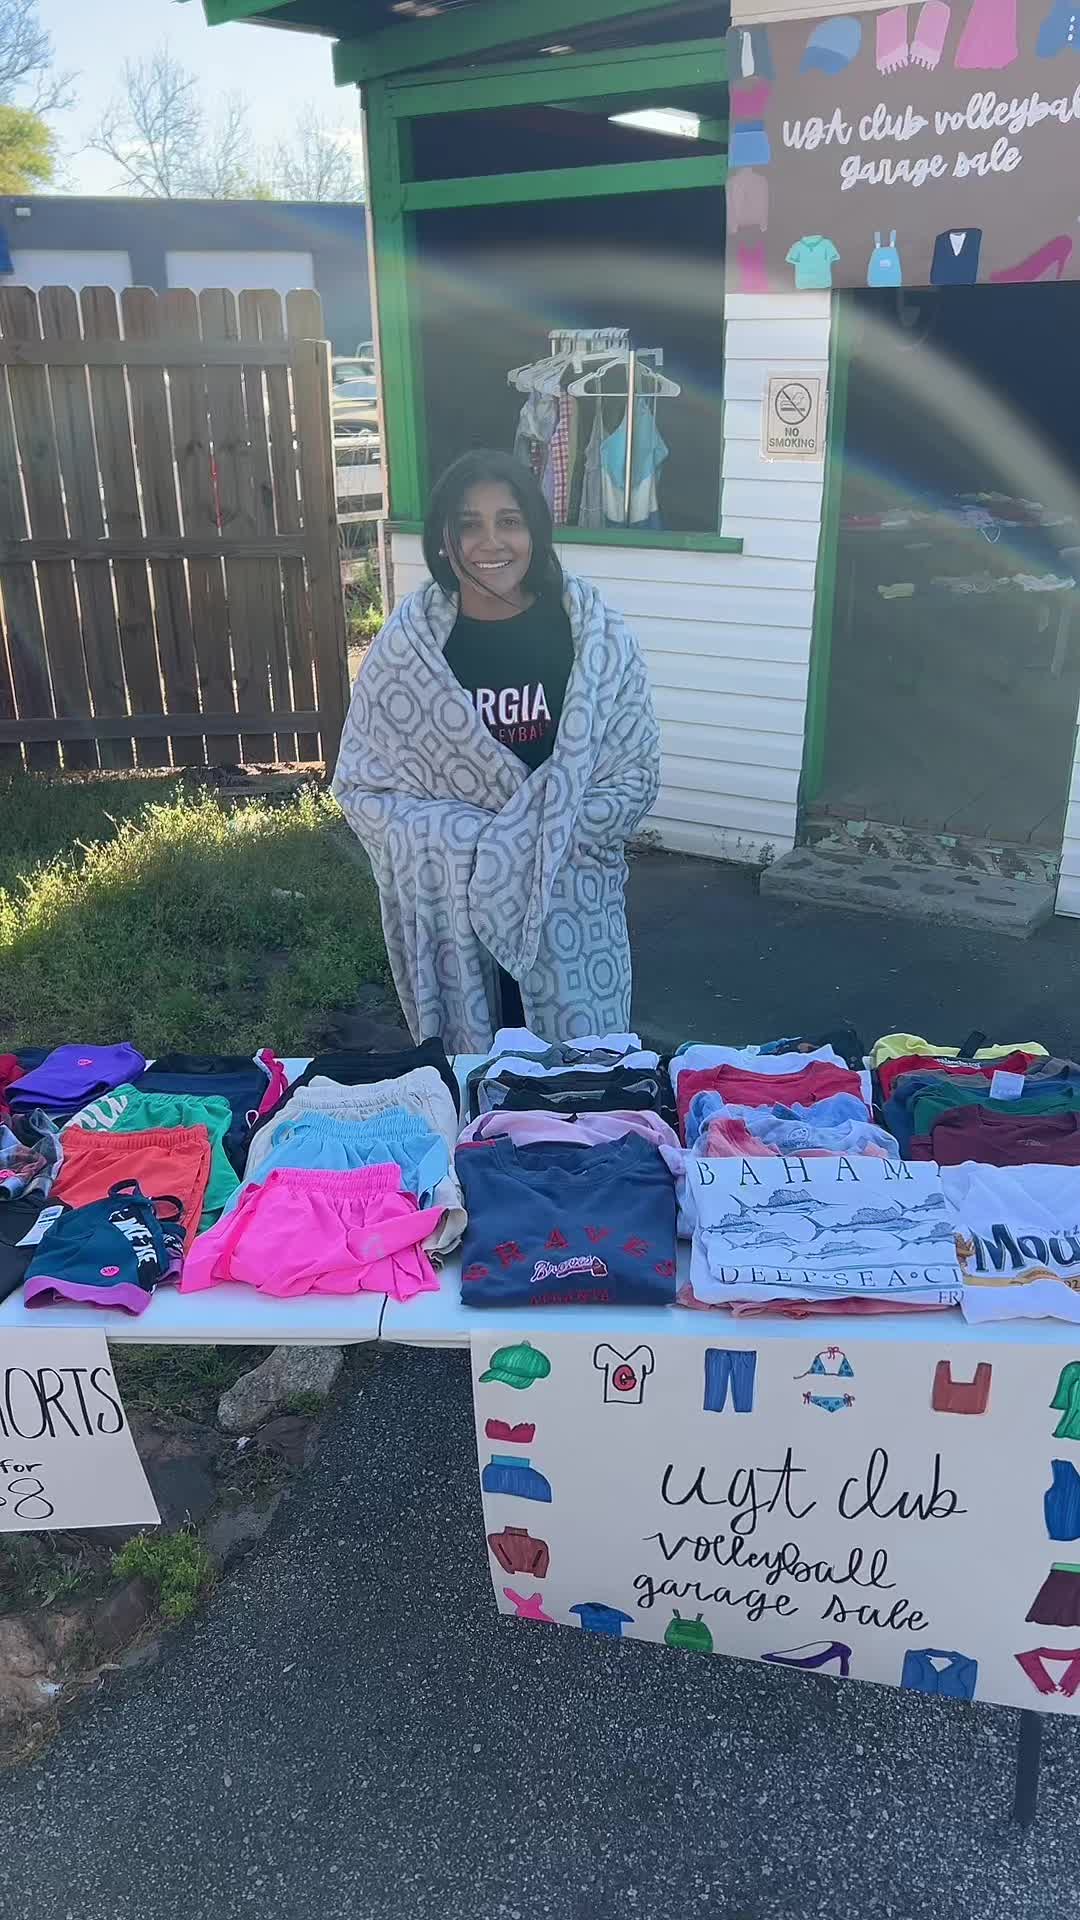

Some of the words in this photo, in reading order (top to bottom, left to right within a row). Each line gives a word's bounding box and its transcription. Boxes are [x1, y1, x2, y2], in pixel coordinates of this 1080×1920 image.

[858, 103, 929, 141] club
[840, 154, 948, 191] garage
[952, 136, 1023, 178] sale
[768, 438, 815, 448] SMOKING
[784, 427, 800, 437] NO
[463, 682, 551, 725] RGIA
[696, 1156, 941, 1187] BAHAM
[0, 1459, 43, 1474] for
[838, 1447, 967, 1520] club
[0, 1477, 54, 1519] 8
[643, 1531, 896, 1588] volleyball
[633, 1574, 800, 1621] garage
[821, 1594, 930, 1631] sale
